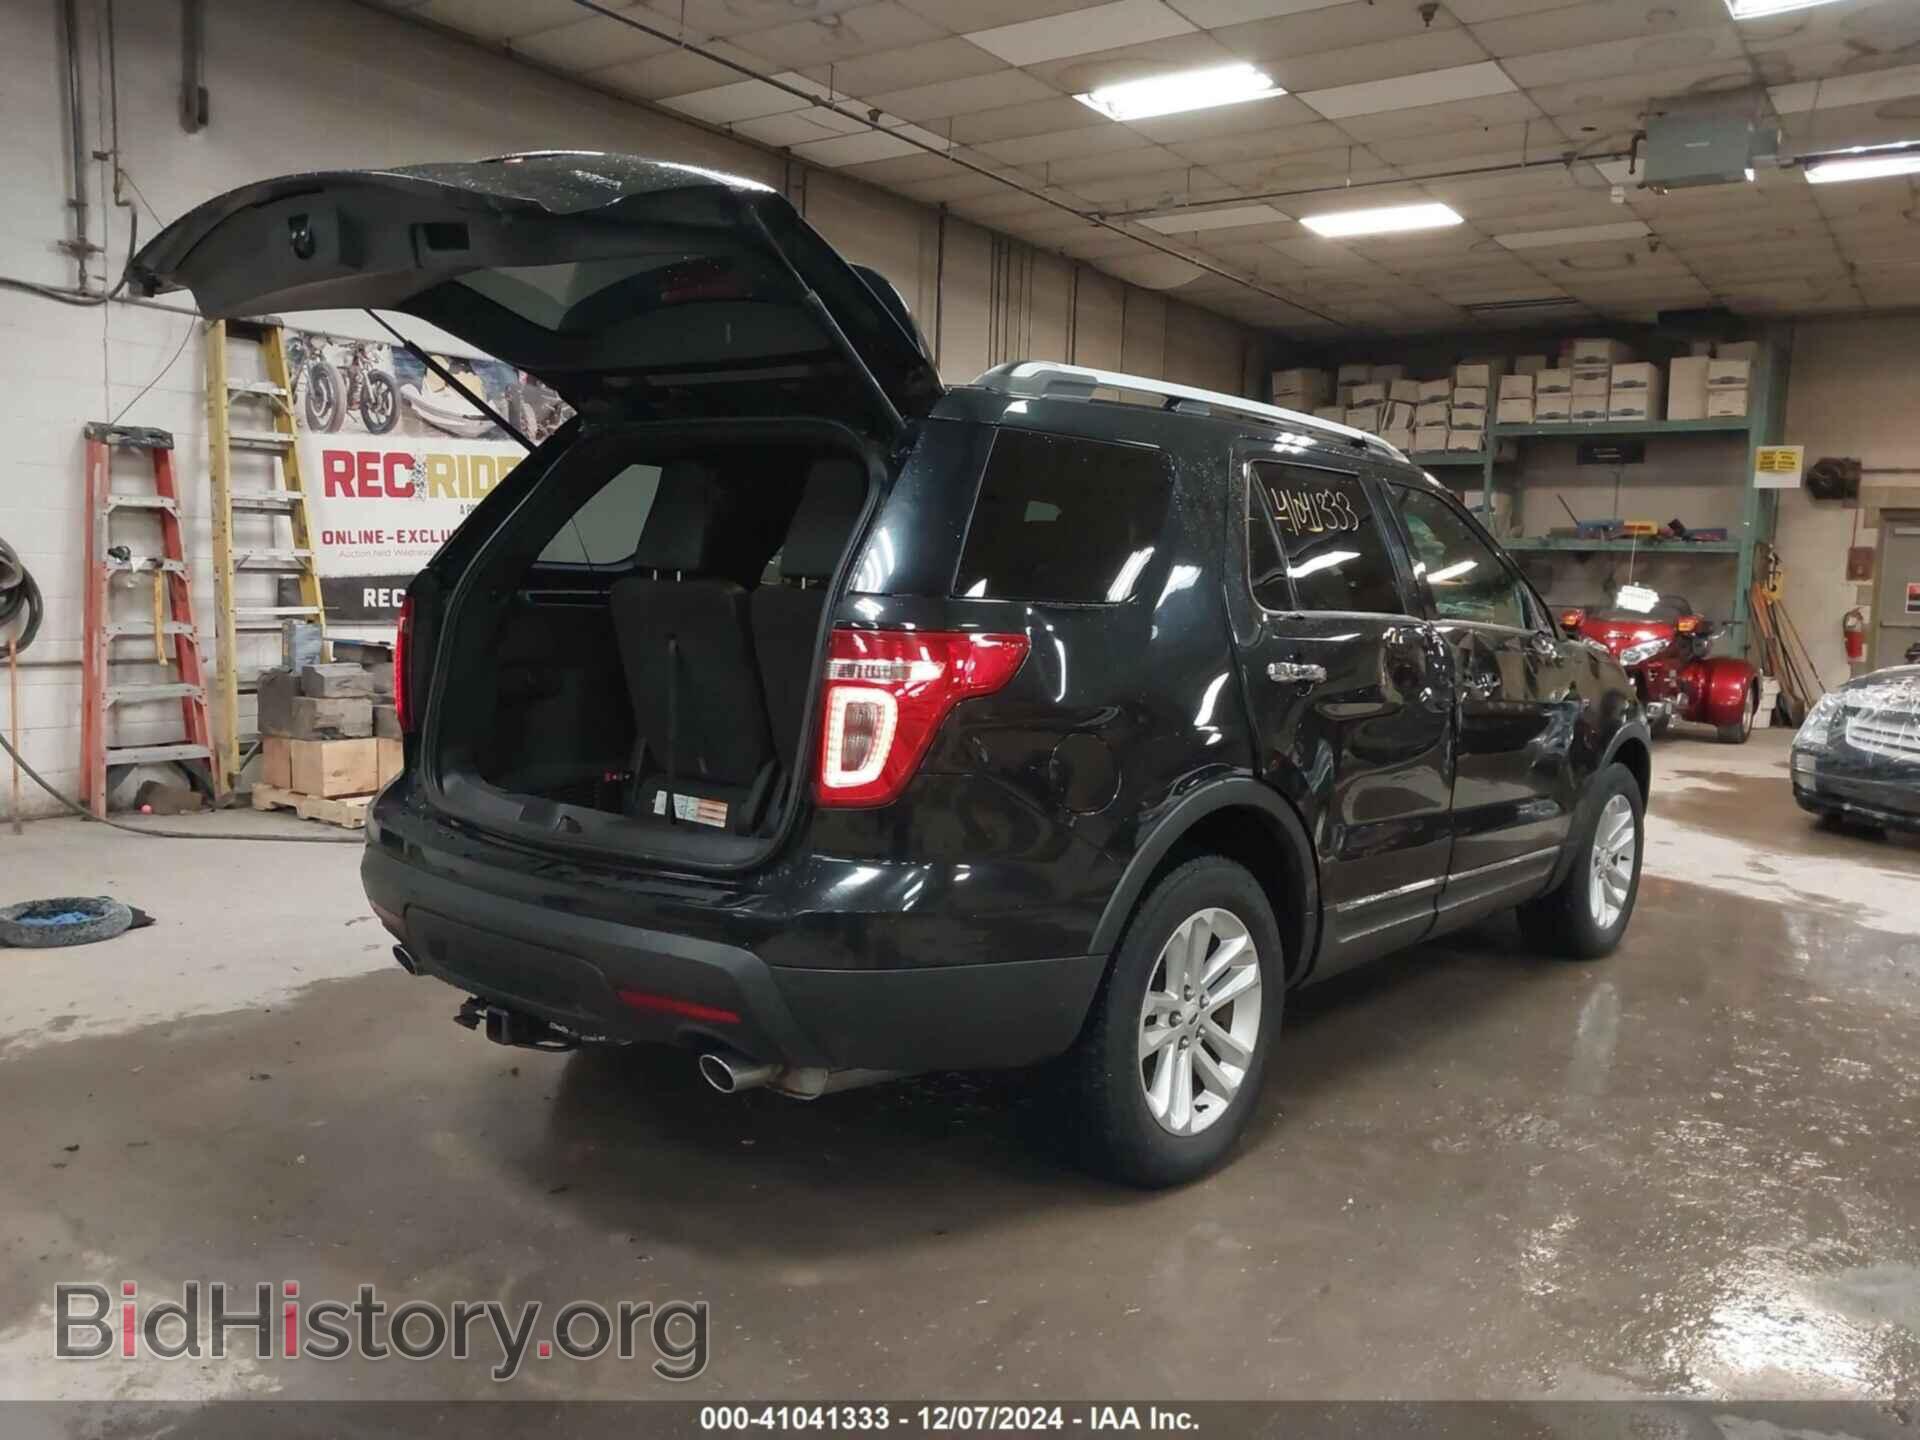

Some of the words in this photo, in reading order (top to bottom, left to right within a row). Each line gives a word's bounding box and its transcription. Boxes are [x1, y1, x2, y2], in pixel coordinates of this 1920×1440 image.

[322, 450, 416, 498] REC
[321, 528, 456, 545] ONLINE-EXCLU
[363, 588, 407, 608] REC
